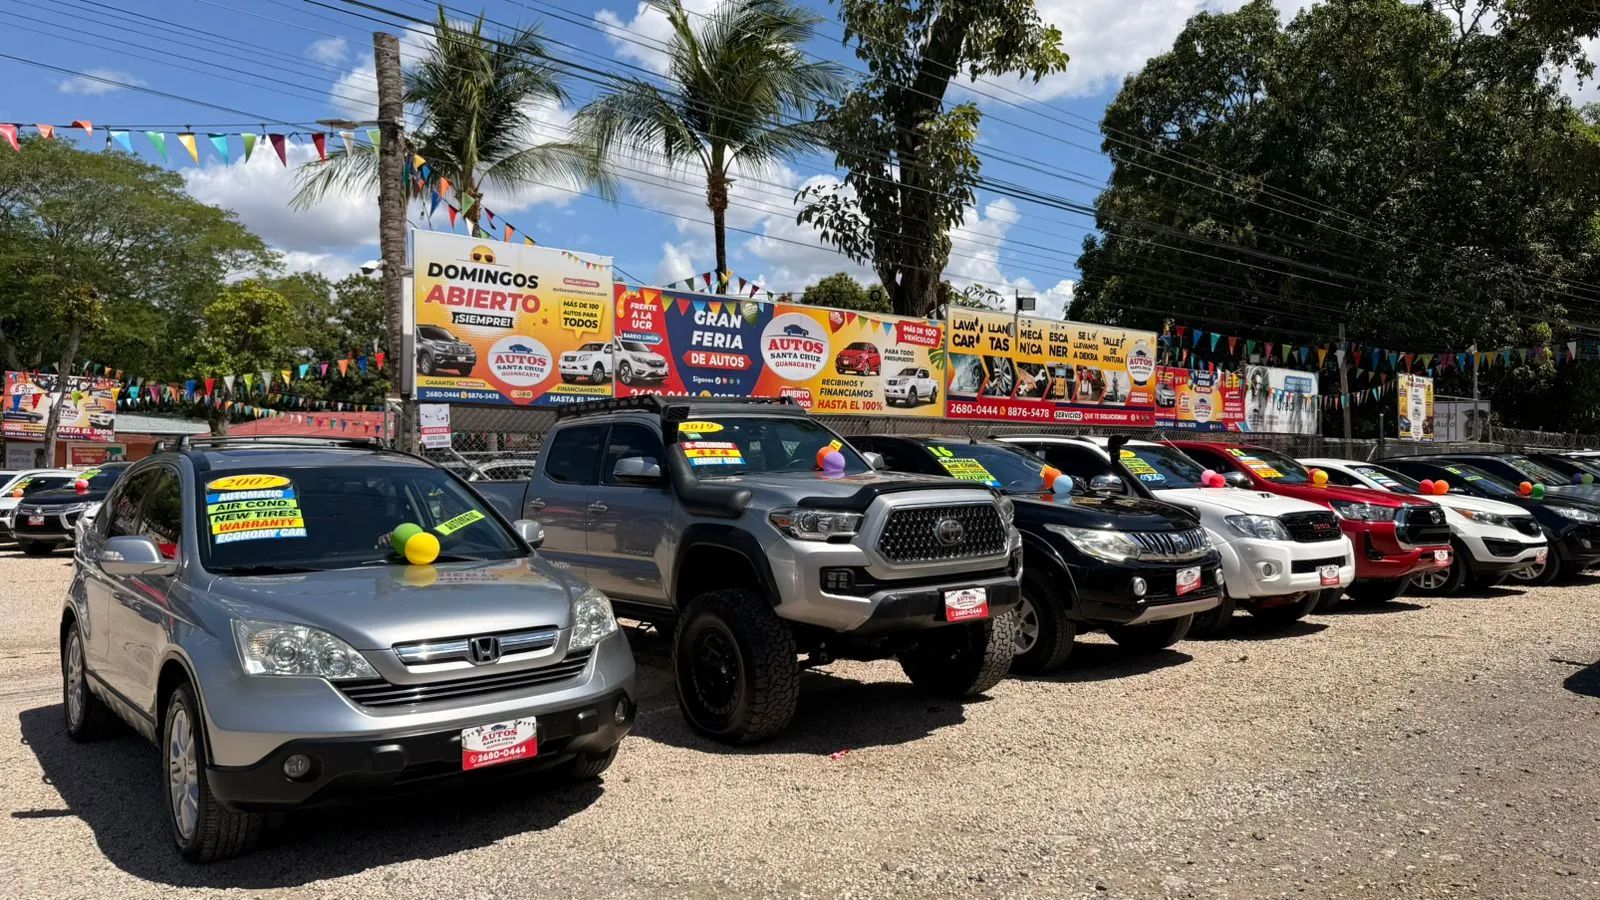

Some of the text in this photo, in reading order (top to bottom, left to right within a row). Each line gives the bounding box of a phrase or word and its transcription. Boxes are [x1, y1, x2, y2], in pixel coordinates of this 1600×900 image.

[427, 262, 539, 289] DOMINGOS
[424, 284, 541, 314] ABIERTO
[563, 300, 578, 308] MÁS
[630, 302, 658, 312] FRENTE
[455, 314, 511, 327] ¡SIEMPRE!
[631, 310, 652, 321] A LA
[694, 310, 742, 329] GRAN
[563, 317, 599, 329] TODOS
[632, 319, 653, 330] UCR
[953, 319, 976, 332] LAVA
[988, 323, 1008, 335] LLAN
[903, 325, 937, 337] MÁS DE 100
[1020, 328, 1043, 341] MECÁ
[1049, 331, 1069, 343] ESCA
[1078, 331, 1086, 340] SE
[691, 330, 743, 350] FERIA
[768, 338, 824, 354] AUTOS
[952, 333, 976, 349] CAR
[988, 336, 1010, 351] TAS
[1073, 341, 1099, 351] LLEVAMOS
[770, 352, 821, 363] SANTA CRUZ
[900, 349, 915, 357] TODO
[1048, 345, 1068, 358] NER
[1073, 352, 1099, 361] A DEKRA
[1109, 347, 1118, 356] DE
[495, 354, 547, 367] AUTOS
[691, 353, 745, 368] DE AUTOS
[775, 361, 817, 370] GUANACASTE
[1103, 355, 1124, 364] PINTURA
[1129, 358, 1153, 366] AUTOS
[557, 385, 606, 394] FINANCIAMIENTO
[821, 379, 865, 388] RECIBIMOS Y
[781, 389, 810, 399] ABIERTO
[820, 387, 874, 398] FINANCIAMOS
[550, 395, 575, 403] HASTA
[817, 399, 848, 410] HASTA
[849, 401, 860, 410] EL
[861, 401, 884, 411] 100%
[950, 403, 1050, 418] 2680-0444 8876-5478
[1055, 411, 1082, 419] SERVICIOS
[222, 477, 275, 488] 2007
[218, 489, 284, 501] AUTOMATIC
[215, 503, 241, 511] AIR
[214, 509, 297, 522] NEW TIRES
[220, 518, 295, 531] WARRANTY
[216, 528, 307, 544] ECONOMY CAR
[481, 729, 517, 742] AUTOS
[477, 745, 526, 762] 2680-0444
